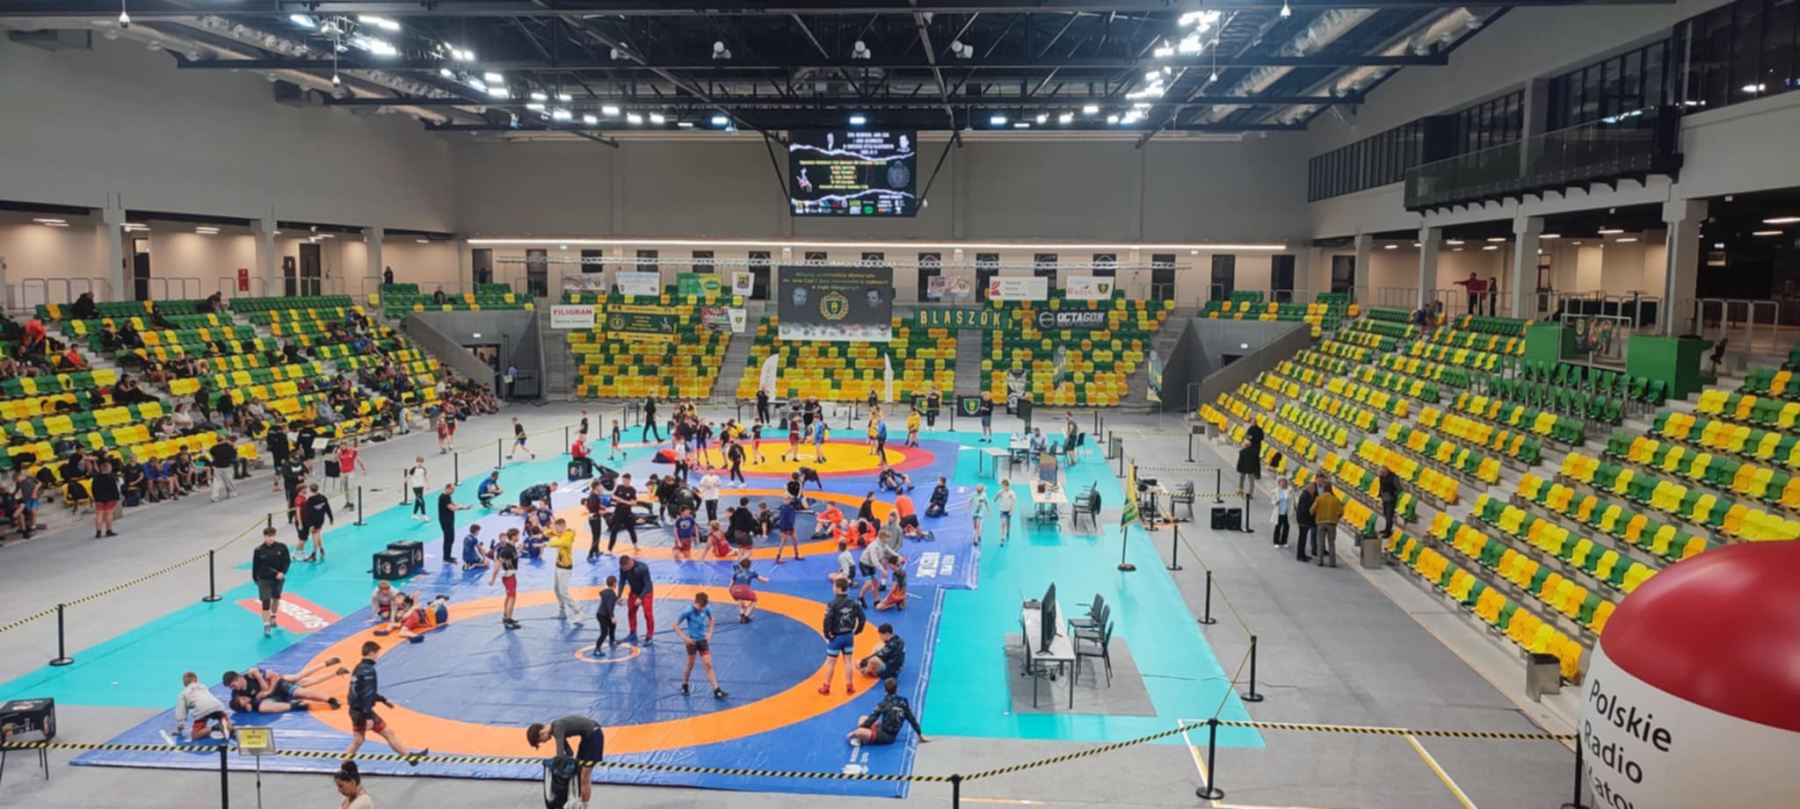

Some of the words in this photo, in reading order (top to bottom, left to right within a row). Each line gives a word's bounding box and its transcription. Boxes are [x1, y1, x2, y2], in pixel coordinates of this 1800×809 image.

[553, 308, 593, 316] FILIGRAN
[920, 310, 1000, 326] BLASZOK
[1057, 311, 1105, 323] OCTAGON
[1588, 679, 1672, 752] Polskie
[1583, 719, 1643, 784] Radio
[1588, 768, 1635, 809] ato
